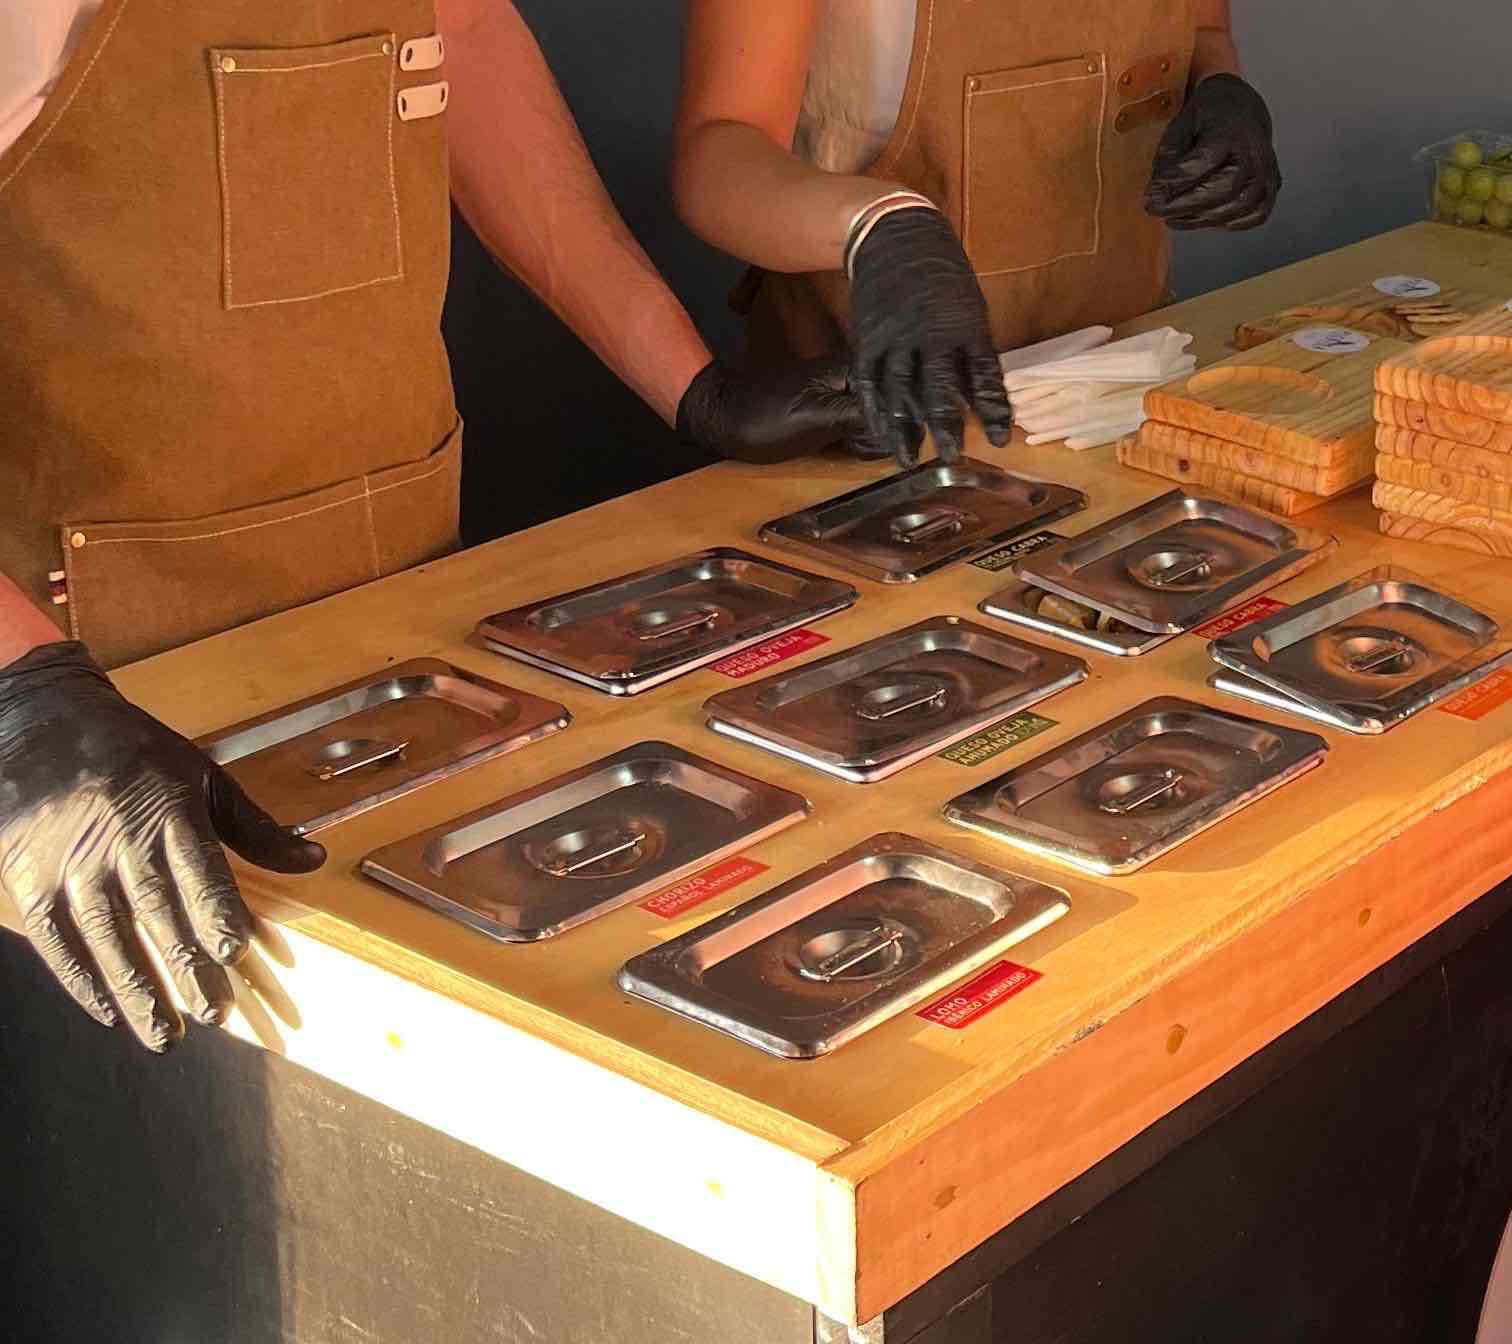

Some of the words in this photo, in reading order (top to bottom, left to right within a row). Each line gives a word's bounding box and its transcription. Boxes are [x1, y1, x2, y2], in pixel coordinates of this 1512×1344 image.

[944, 736, 989, 761] QUESO
[989, 718, 1026, 743] OVEJA
[958, 733, 1019, 765] AHUMADO
[647, 877, 707, 908] CHORIZO
[929, 996, 968, 1023] LOMO
